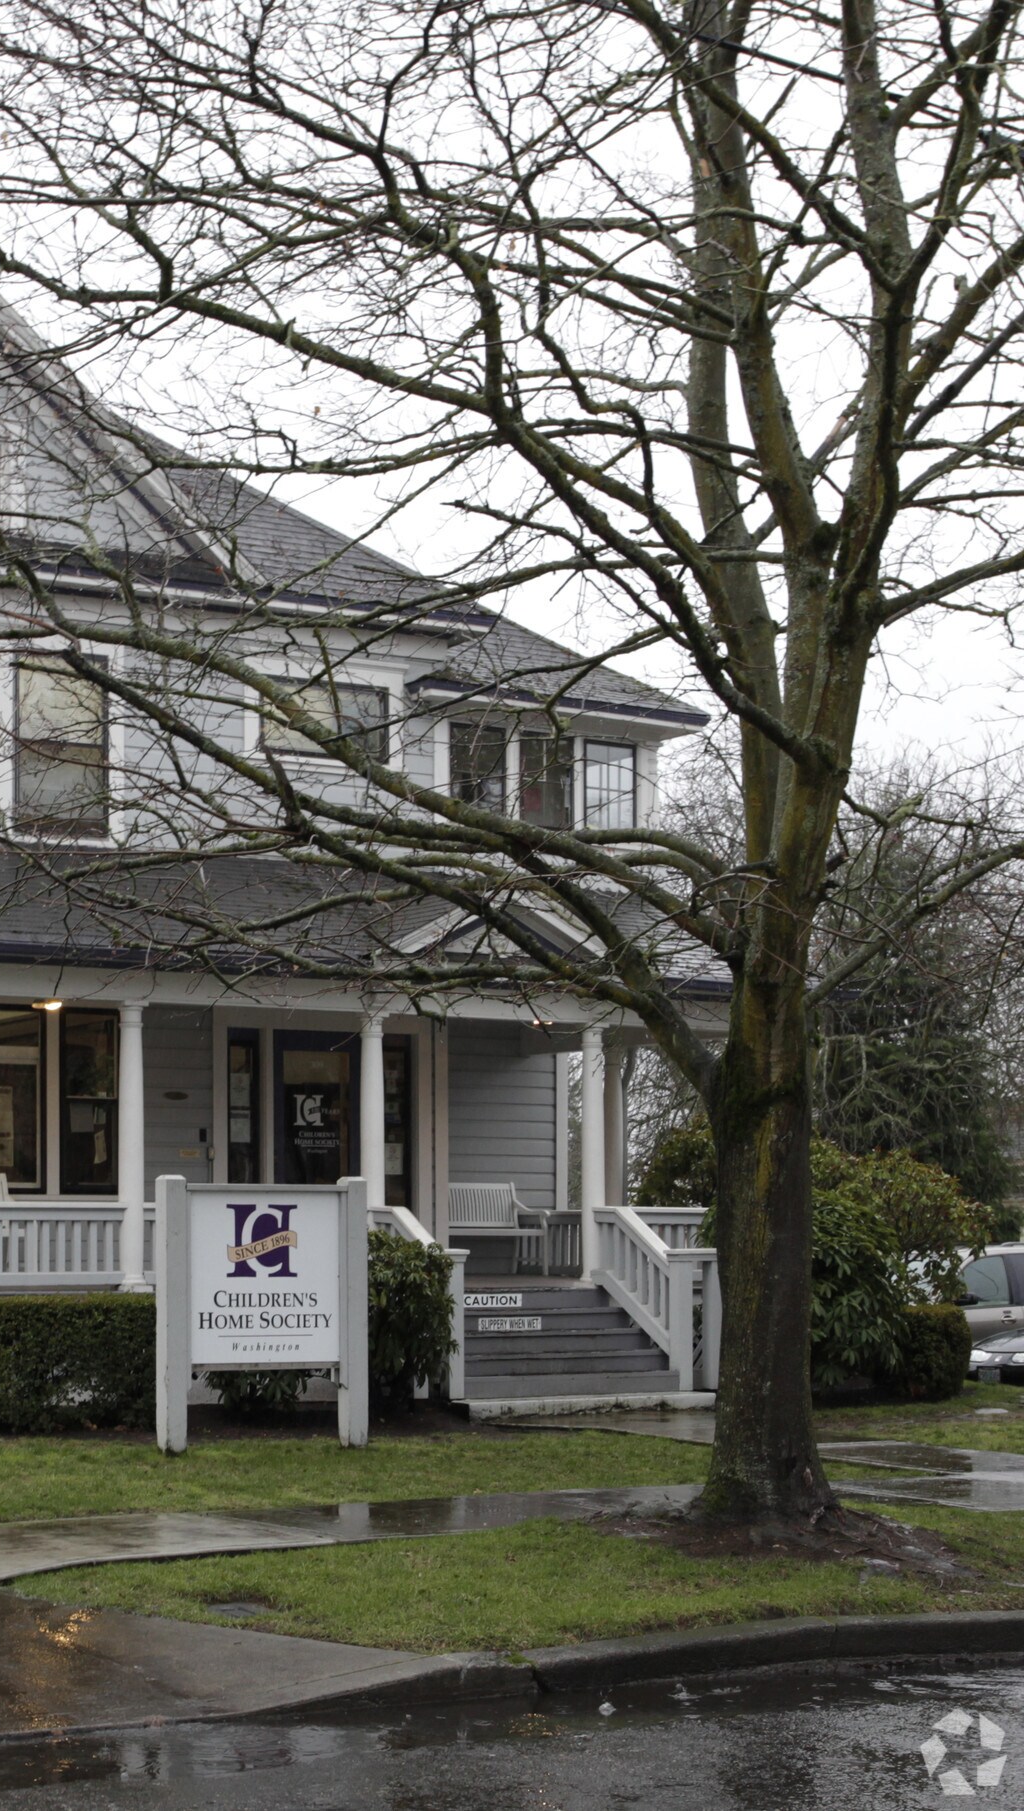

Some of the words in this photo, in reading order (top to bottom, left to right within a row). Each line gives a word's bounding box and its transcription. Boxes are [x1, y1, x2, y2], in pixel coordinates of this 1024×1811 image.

[235, 1239, 269, 1261] SINCE
[271, 1233, 291, 1248] 1896
[213, 1290, 318, 1309] CHILDREN'S
[464, 1295, 518, 1306] CAUTION
[198, 1312, 254, 1330] HOME
[259, 1311, 333, 1330] SOCIETY
[480, 1319, 508, 1330] SLIPPERY
[509, 1318, 526, 1329] WHEN
[527, 1318, 539, 1329] WET
[232, 1342, 301, 1353] Washington
